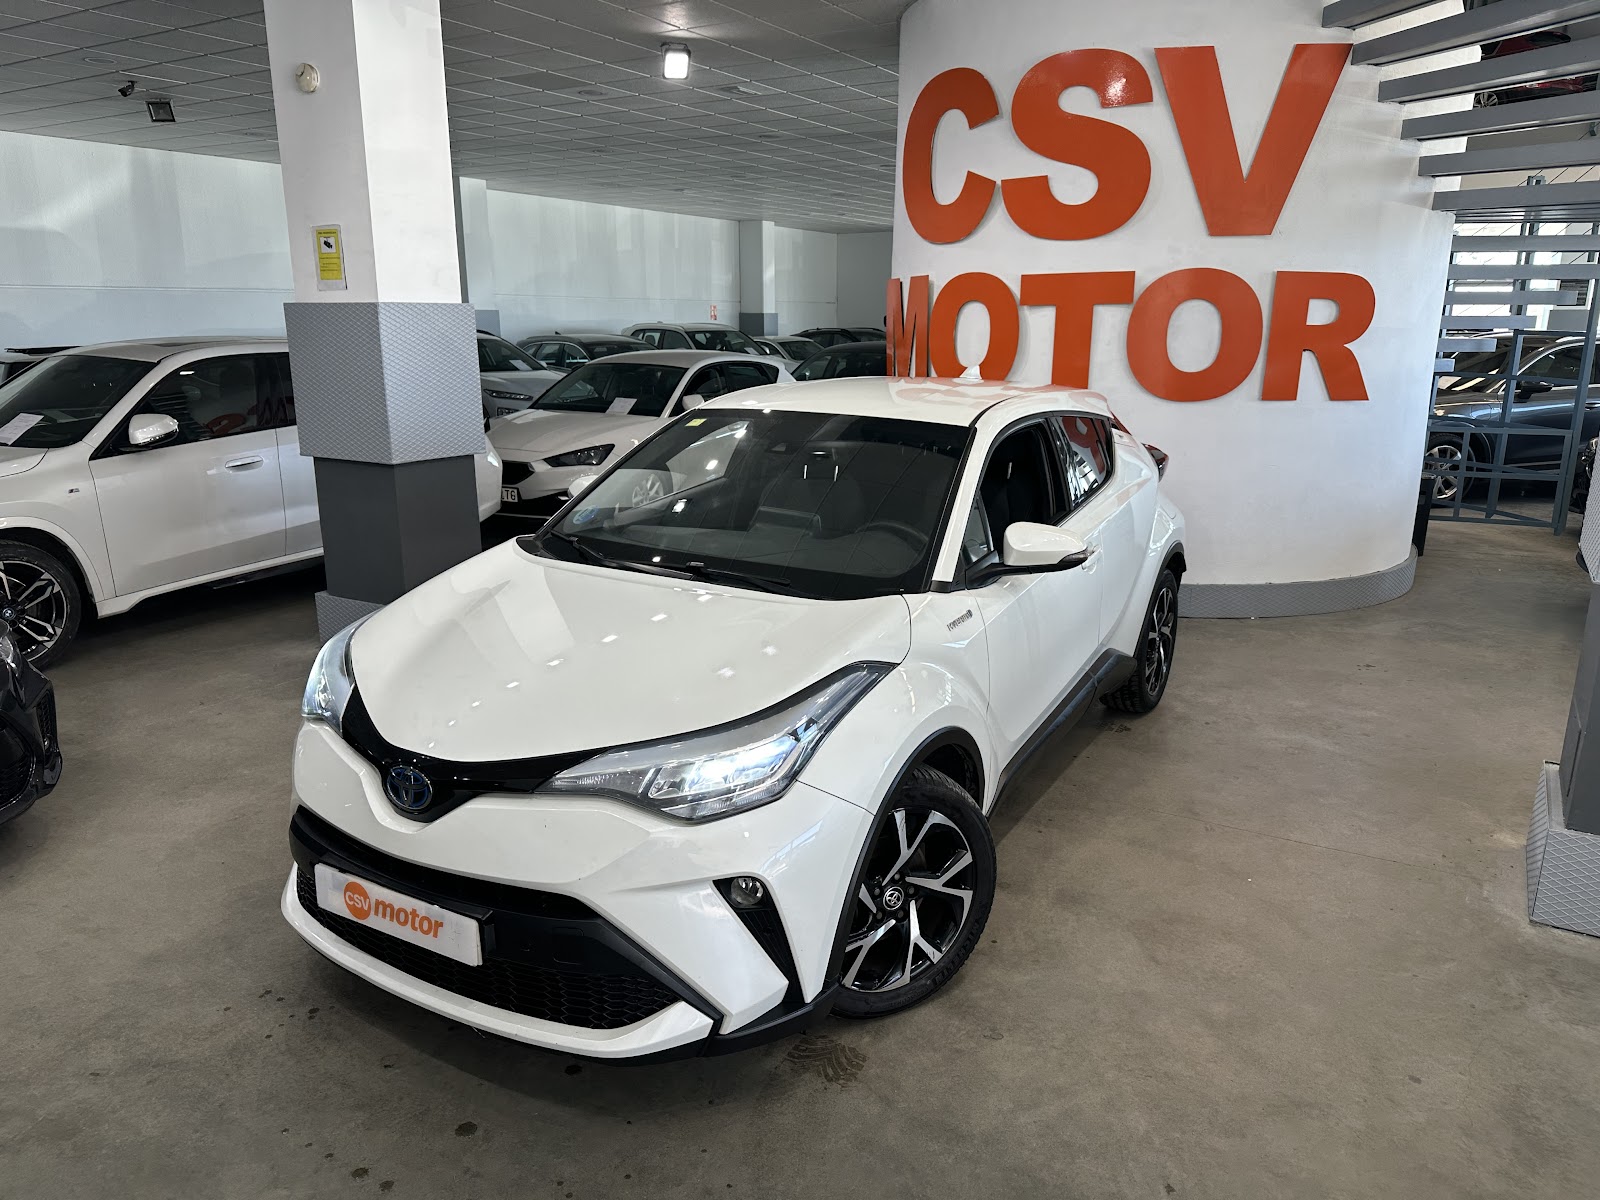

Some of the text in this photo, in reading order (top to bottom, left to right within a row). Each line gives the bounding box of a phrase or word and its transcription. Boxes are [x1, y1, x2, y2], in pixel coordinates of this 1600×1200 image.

[902, 43, 1352, 244] CSV
[886, 268, 1376, 402] MOTOR
[374, 899, 443, 938] motor
